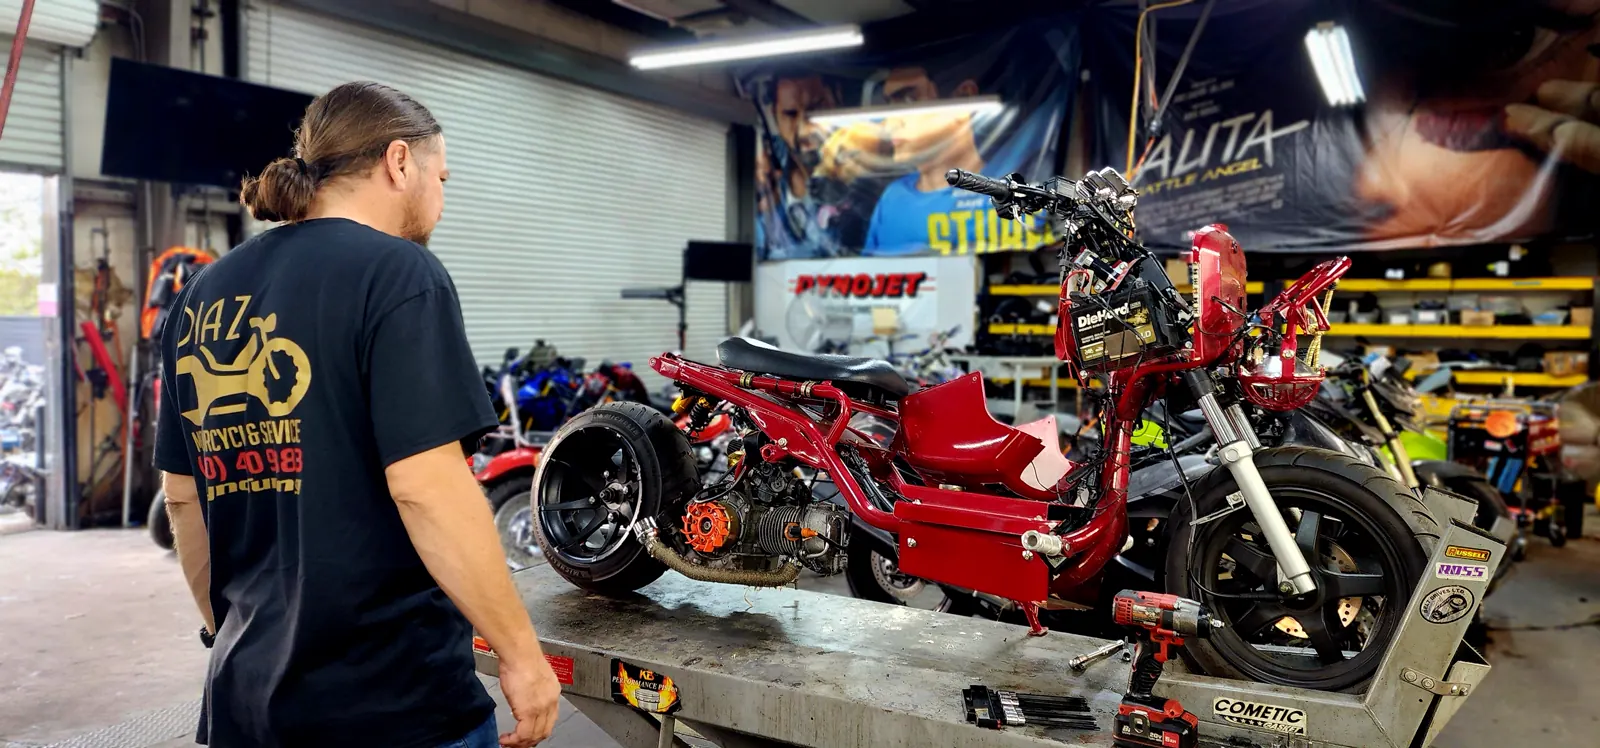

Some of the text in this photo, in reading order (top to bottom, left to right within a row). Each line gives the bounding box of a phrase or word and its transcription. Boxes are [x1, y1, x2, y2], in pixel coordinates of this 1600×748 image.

[1129, 109, 1310, 188] ALITA
[1201, 158, 1262, 182] ANGEL
[795, 272, 926, 298] DYNOJET
[177, 295, 252, 348] DIAZ
[245, 422, 261, 446] &
[1448, 547, 1486, 559] RUSSELL
[1437, 564, 1486, 577] ROSS
[1215, 699, 1304, 723] COMETIC
